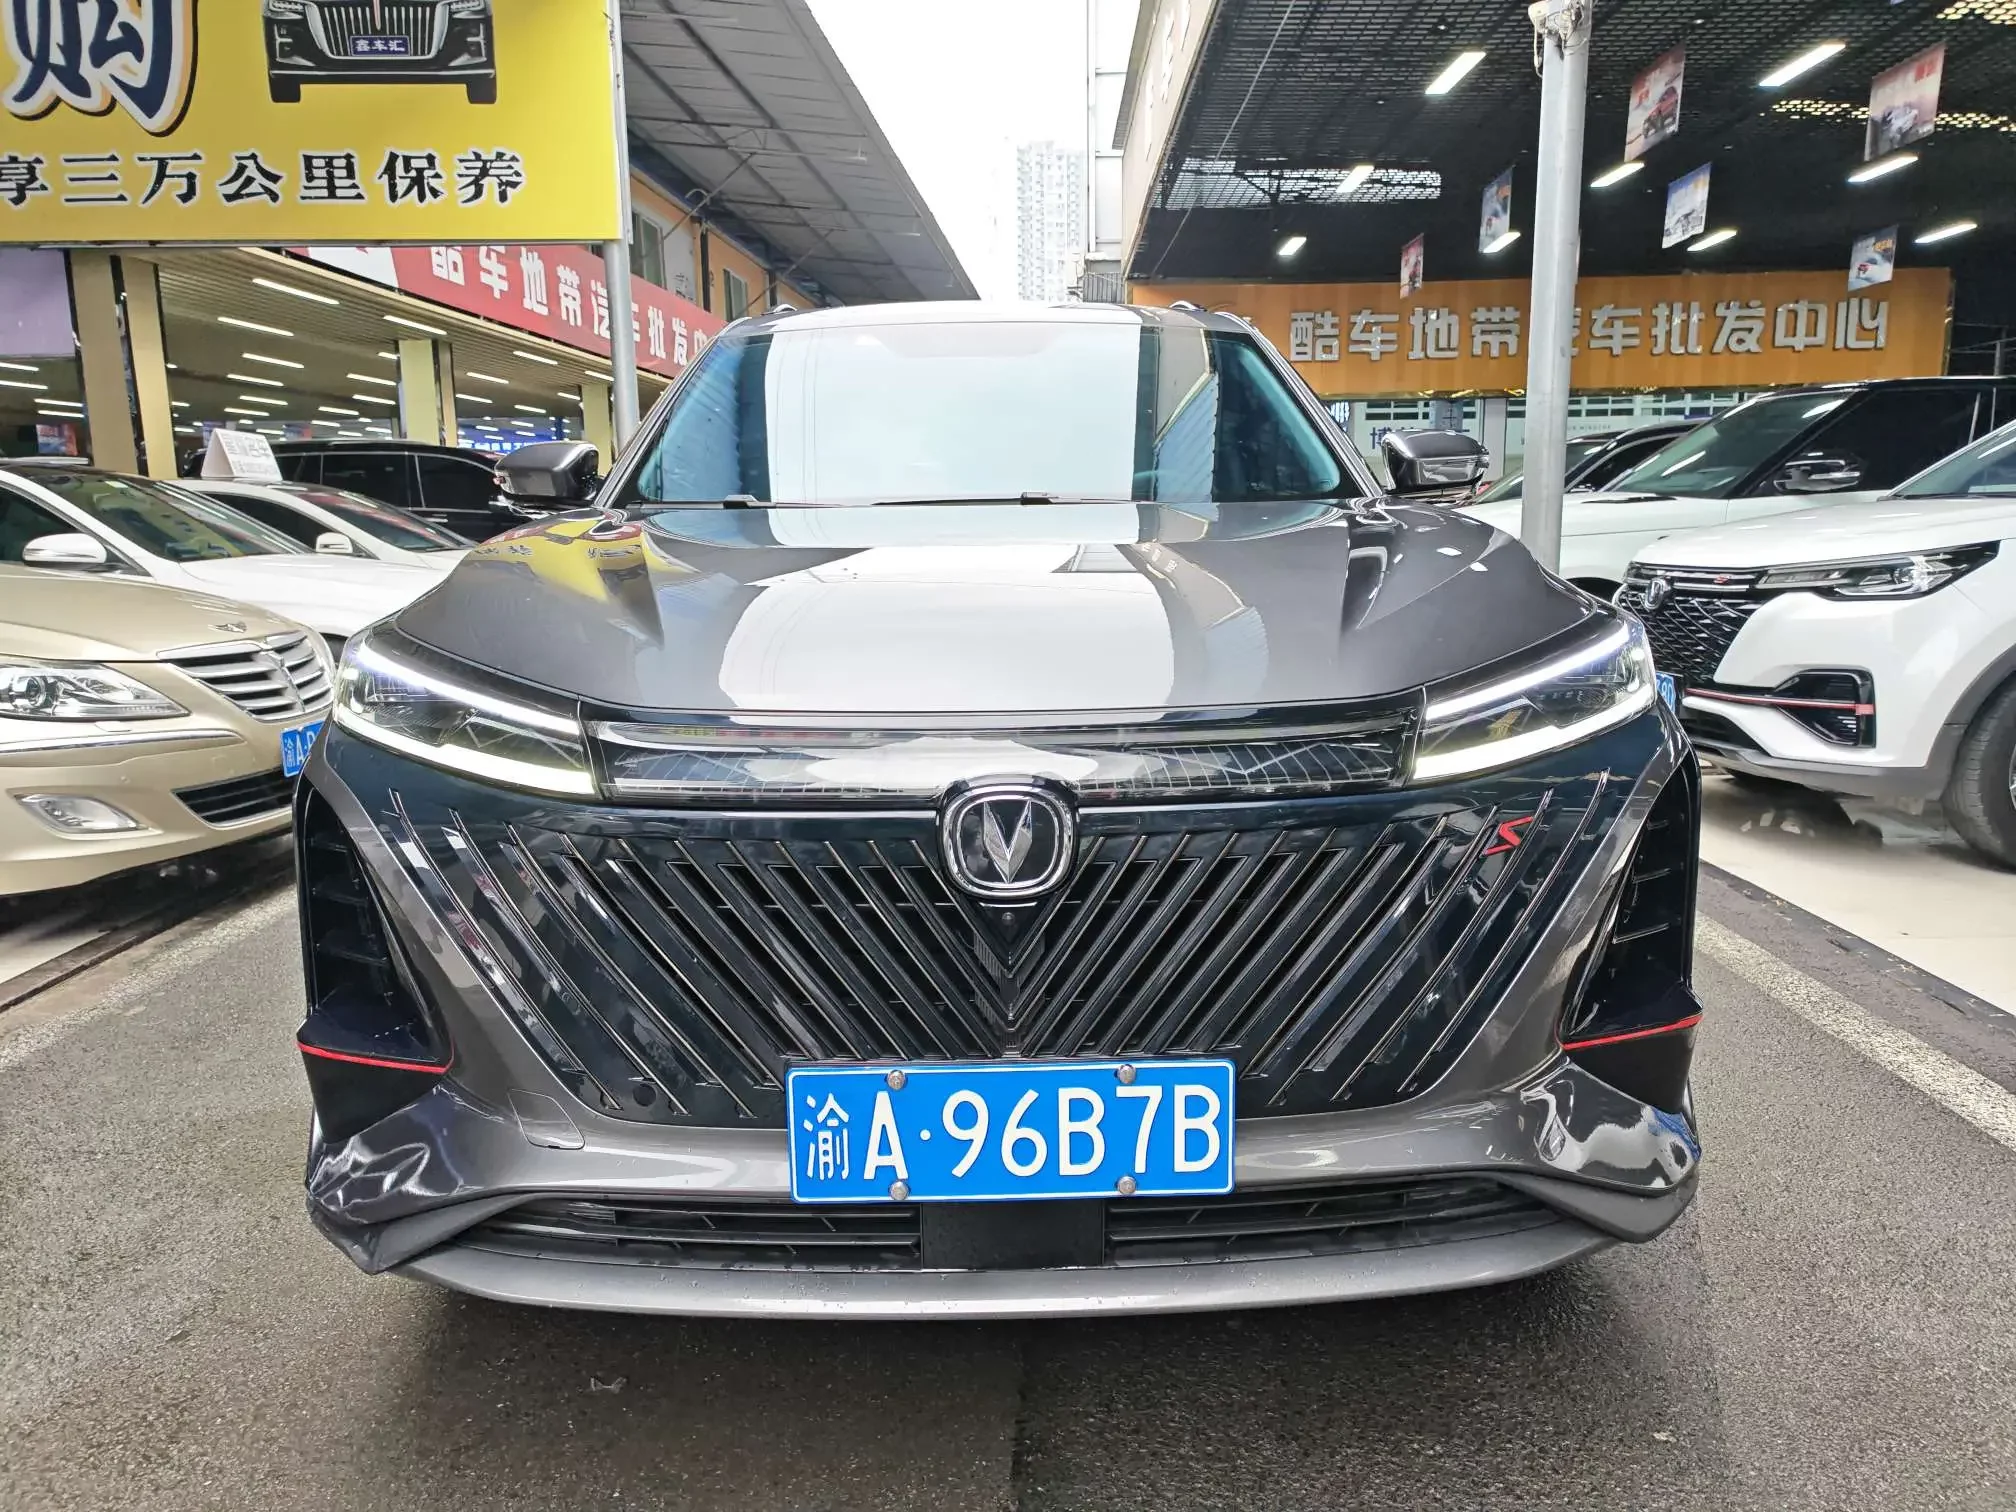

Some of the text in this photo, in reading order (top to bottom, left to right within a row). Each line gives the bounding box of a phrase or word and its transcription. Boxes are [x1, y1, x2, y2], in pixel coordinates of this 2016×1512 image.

[0, 152, 523, 206] 享三万公里保养
[1289, 298, 1889, 362] 酷车地带车批发中心
[802, 1083, 1222, 1181] 渝A·96B7B
